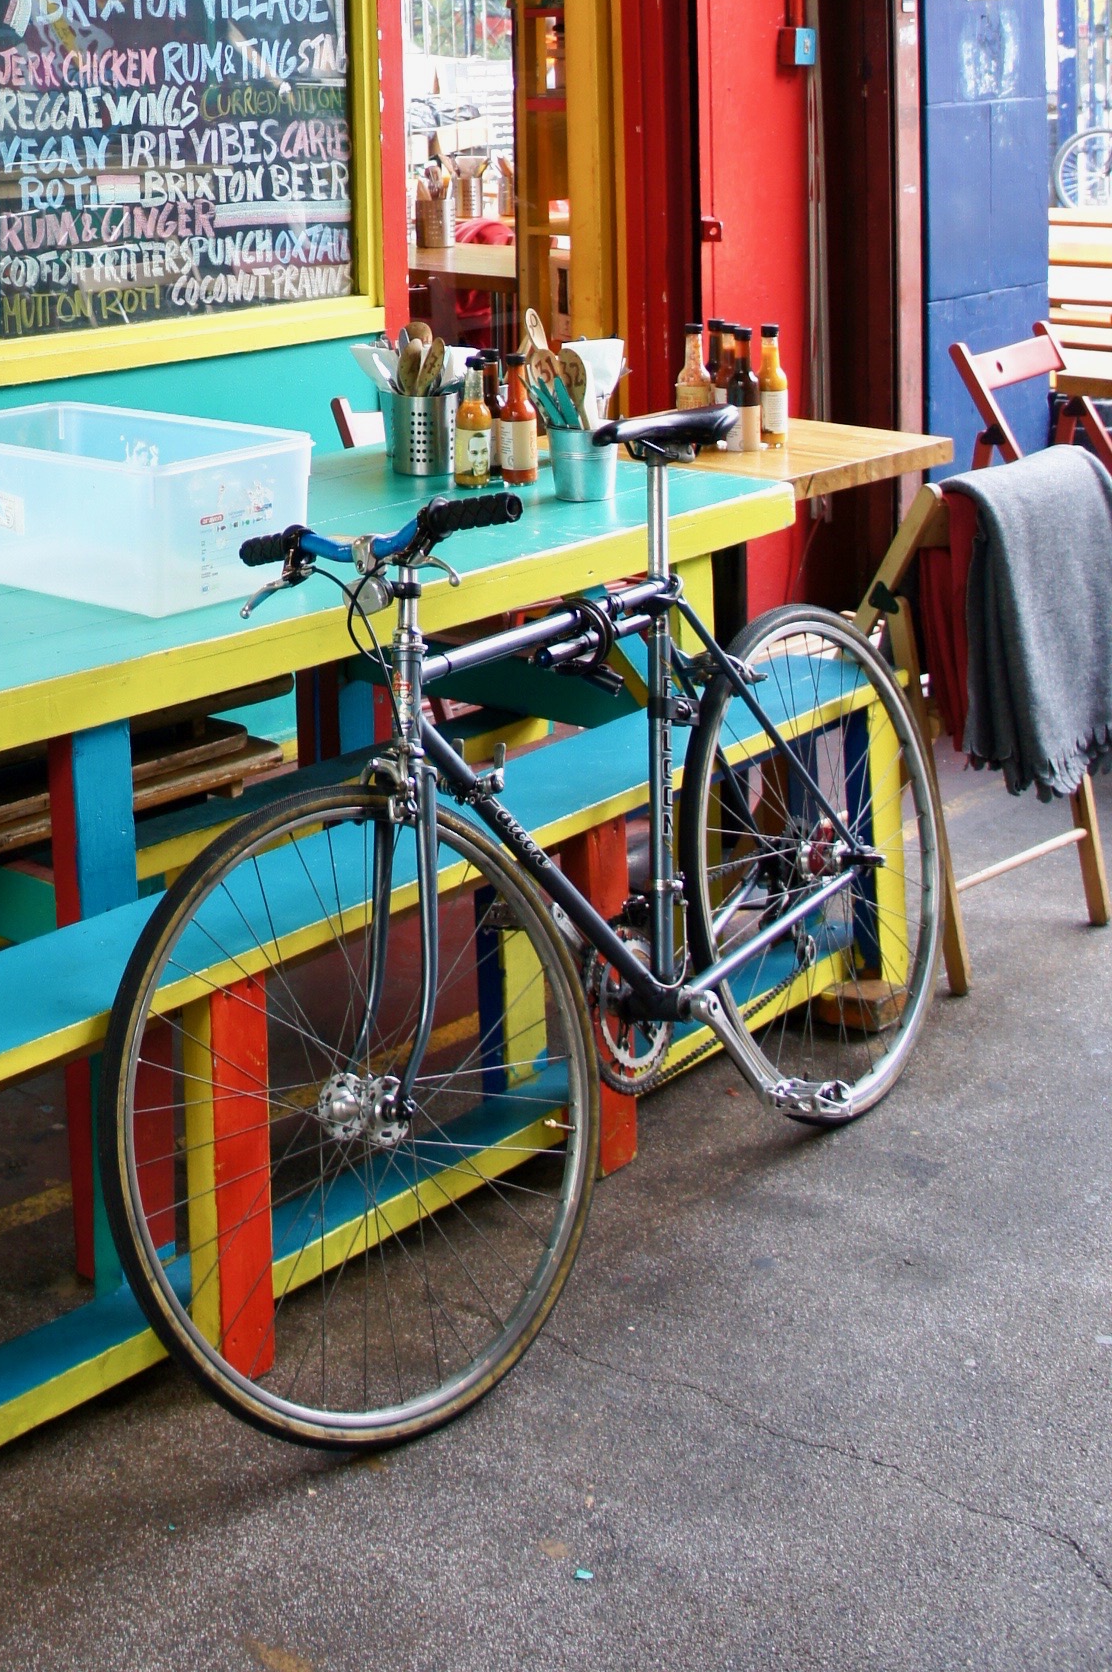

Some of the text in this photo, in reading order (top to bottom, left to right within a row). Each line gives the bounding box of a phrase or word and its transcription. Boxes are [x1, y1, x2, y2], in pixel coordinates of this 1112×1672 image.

[62, 46, 158, 89] CHICKEN
[102, 84, 200, 129] WINGS
[121, 128, 186, 170] IRIE
[188, 118, 280, 165] VIBES
[279, 117, 353, 162] CARIB
[18, 159, 350, 212] ROTI BRIXTON BEER
[0, 210, 80, 253] RUM
[100, 198, 217, 244] GINGER
[171, 267, 272, 307] COCONUT
[1, 289, 93, 335] MUTTON
